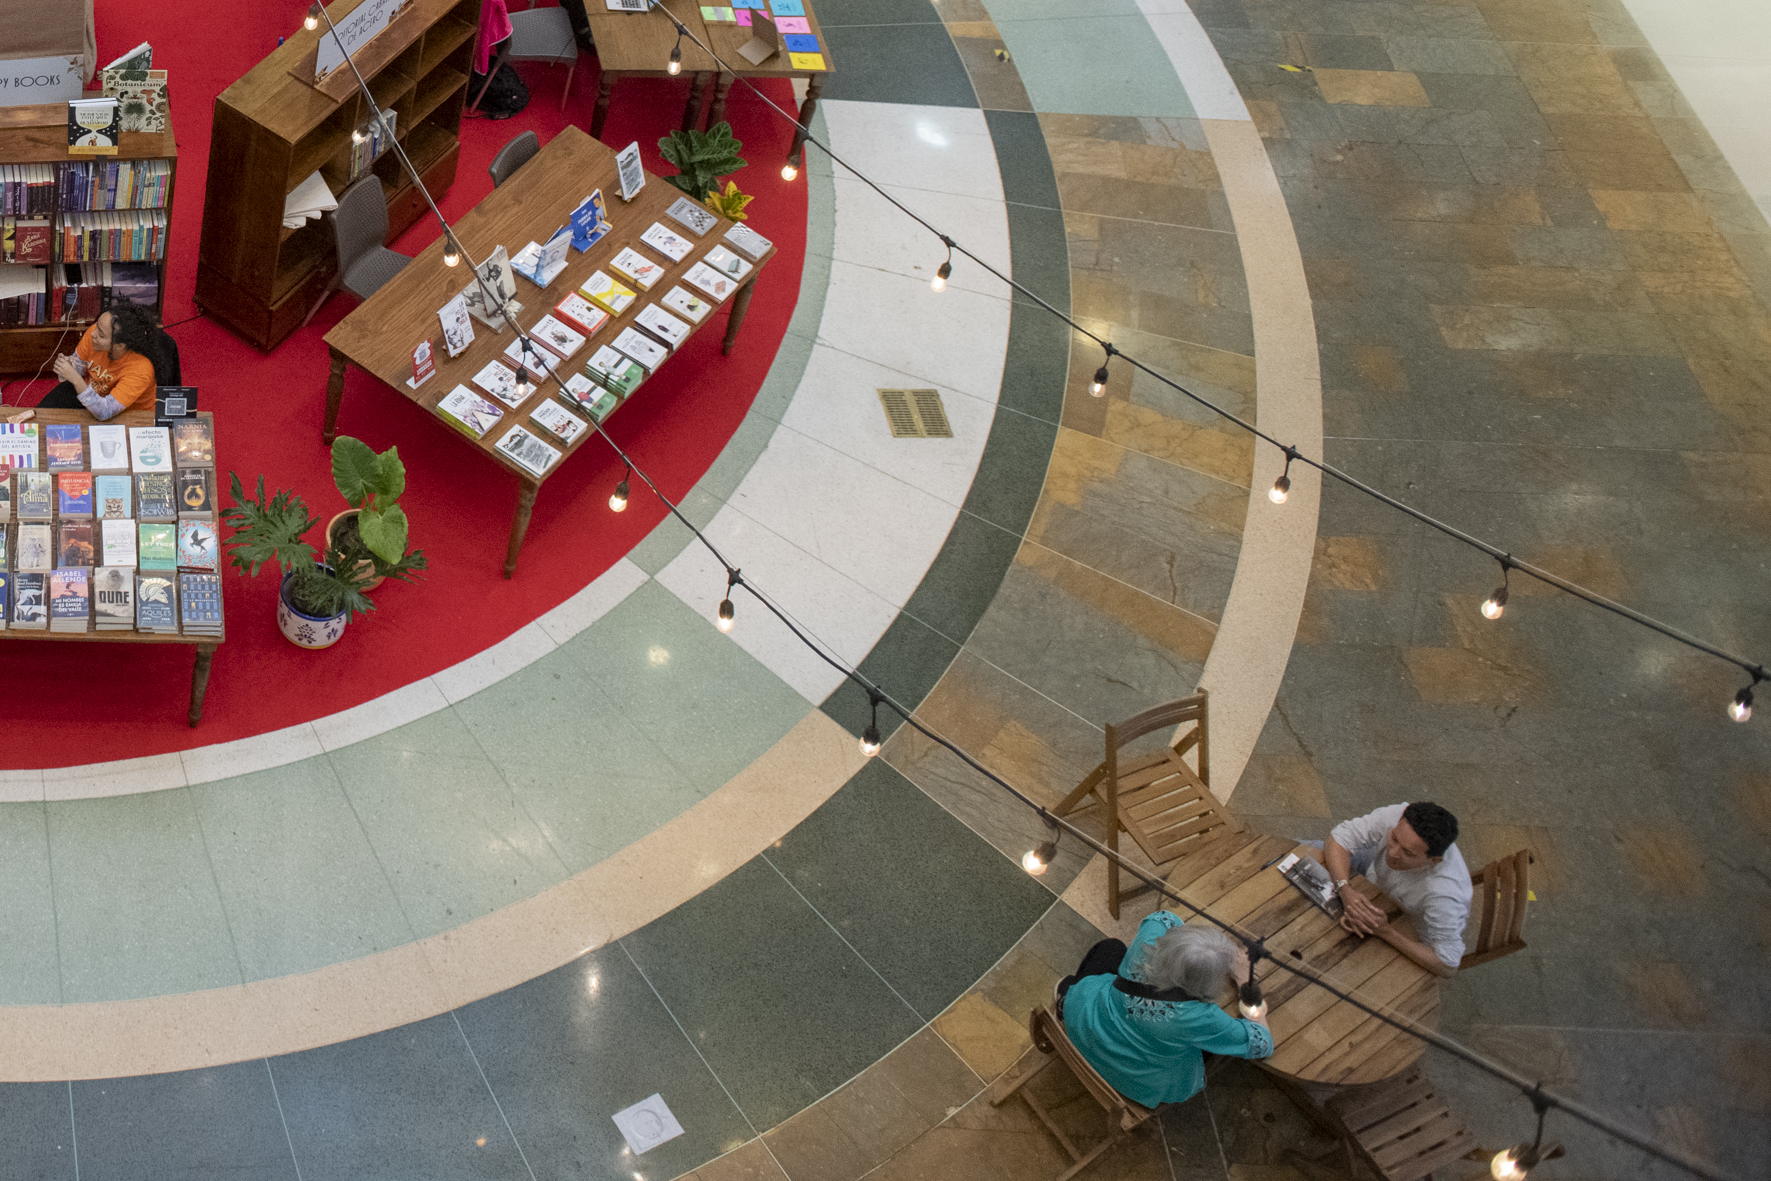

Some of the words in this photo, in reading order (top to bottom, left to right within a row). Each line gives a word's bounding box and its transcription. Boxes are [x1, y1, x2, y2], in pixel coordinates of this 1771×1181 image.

[334, 12, 367, 46] DITORIAL
[347, 30, 357, 46] DE
[359, 9, 384, 37] ACERO
[14, 74, 61, 88] BOOKS
[99, 590, 130, 604] DUNE
[141, 609, 172, 617] AQUILES
